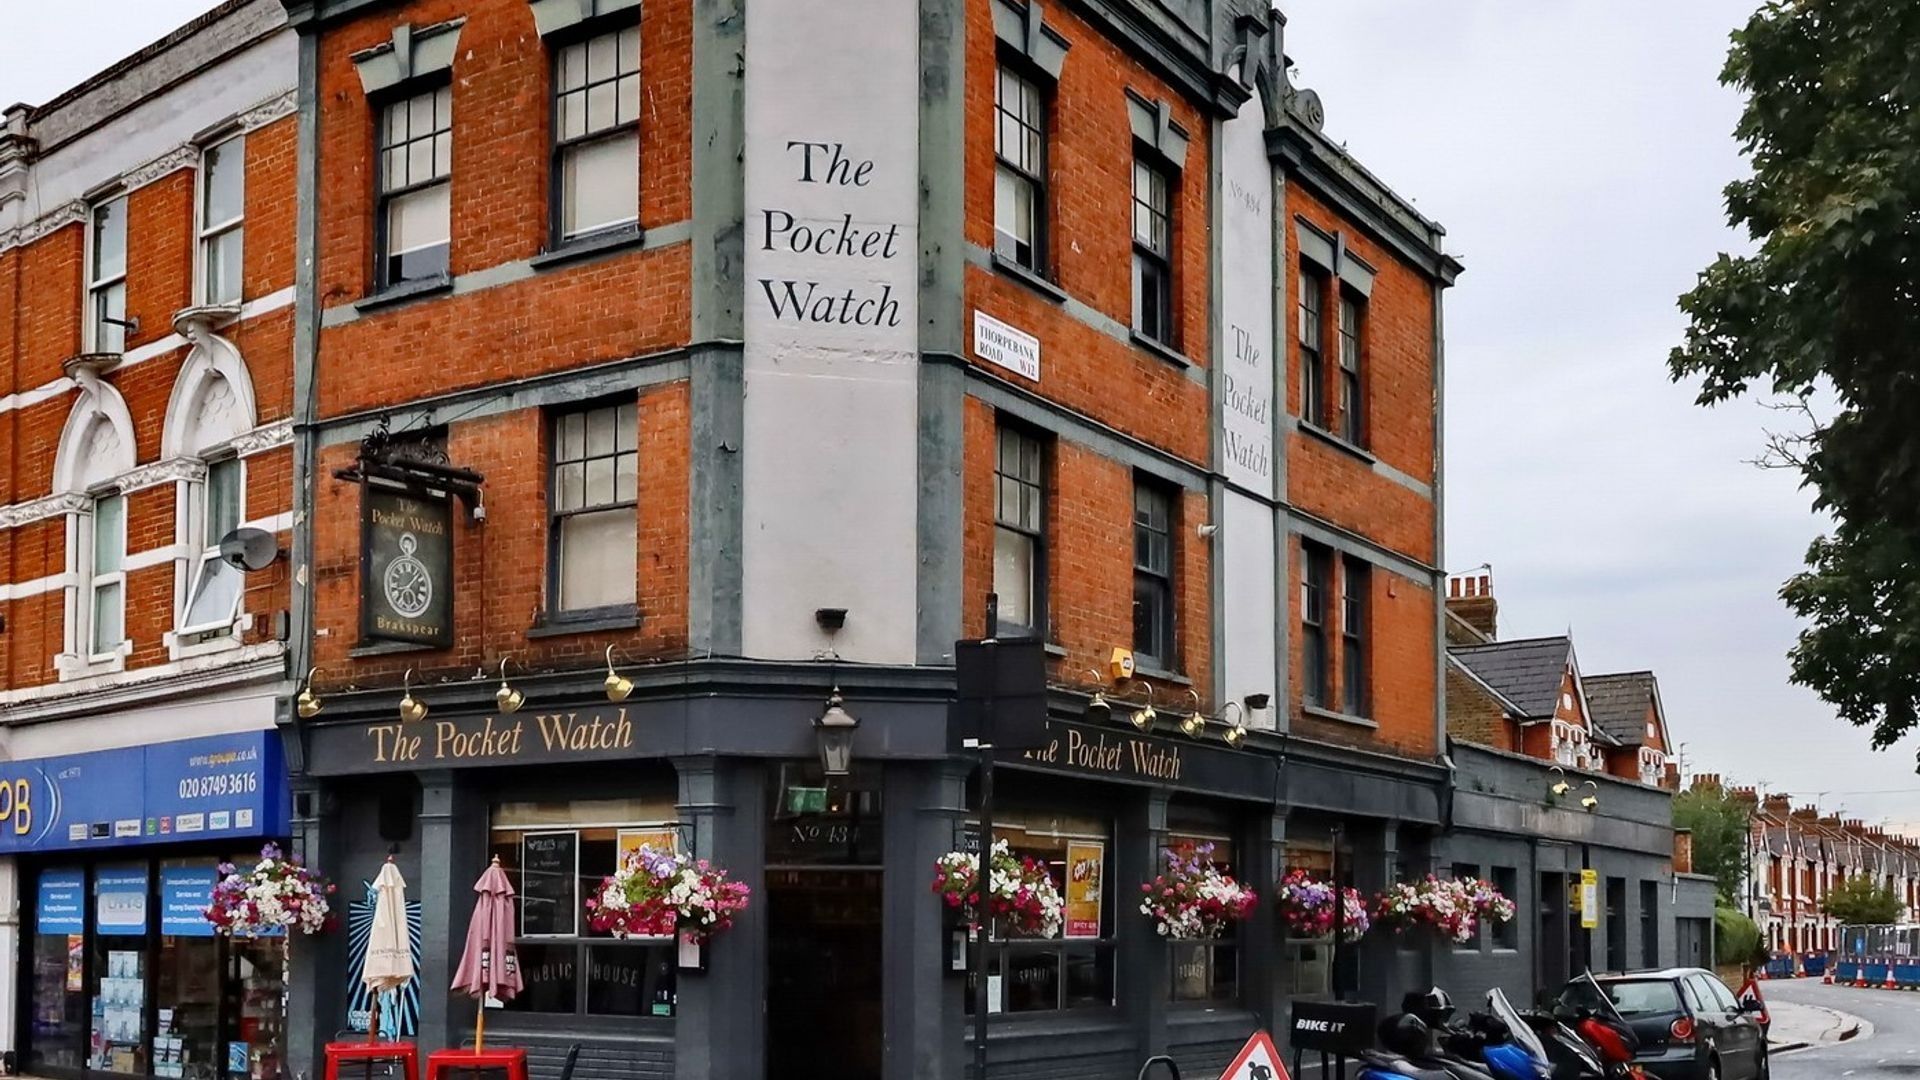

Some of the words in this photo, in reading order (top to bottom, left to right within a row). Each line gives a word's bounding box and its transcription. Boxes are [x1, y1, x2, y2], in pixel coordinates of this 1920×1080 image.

[787, 141, 874, 187] The
[761, 209, 900, 259] Pocket
[758, 279, 901, 328] Watch
[978, 325, 1035, 361] THORPEBANK
[979, 342, 1004, 361] ROAD
[1231, 324, 1260, 368] The
[1019, 359, 1035, 377] W12
[1223, 373, 1267, 425] Pocket
[1223, 427, 1269, 477] Watch
[372, 509, 405, 529] Pocket
[409, 516, 444, 536] Watch
[396, 498, 418, 513] The
[377, 616, 440, 635] Brakspear
[368, 725, 421, 763] The
[435, 718, 522, 759] Pocket
[536, 708, 632, 751] Watch
[1067, 730, 1122, 771] Pocket
[1130, 740, 1181, 780] Watch
[179, 778, 199, 799] 020
[200, 775, 228, 797] 8749
[228, 771, 256, 795] 3616
[525, 962, 572, 982] PUBLIC
[593, 963, 638, 987] HOUSE
[1296, 1018, 1328, 1032] BIKE
[1331, 1021, 1345, 1033] IT
